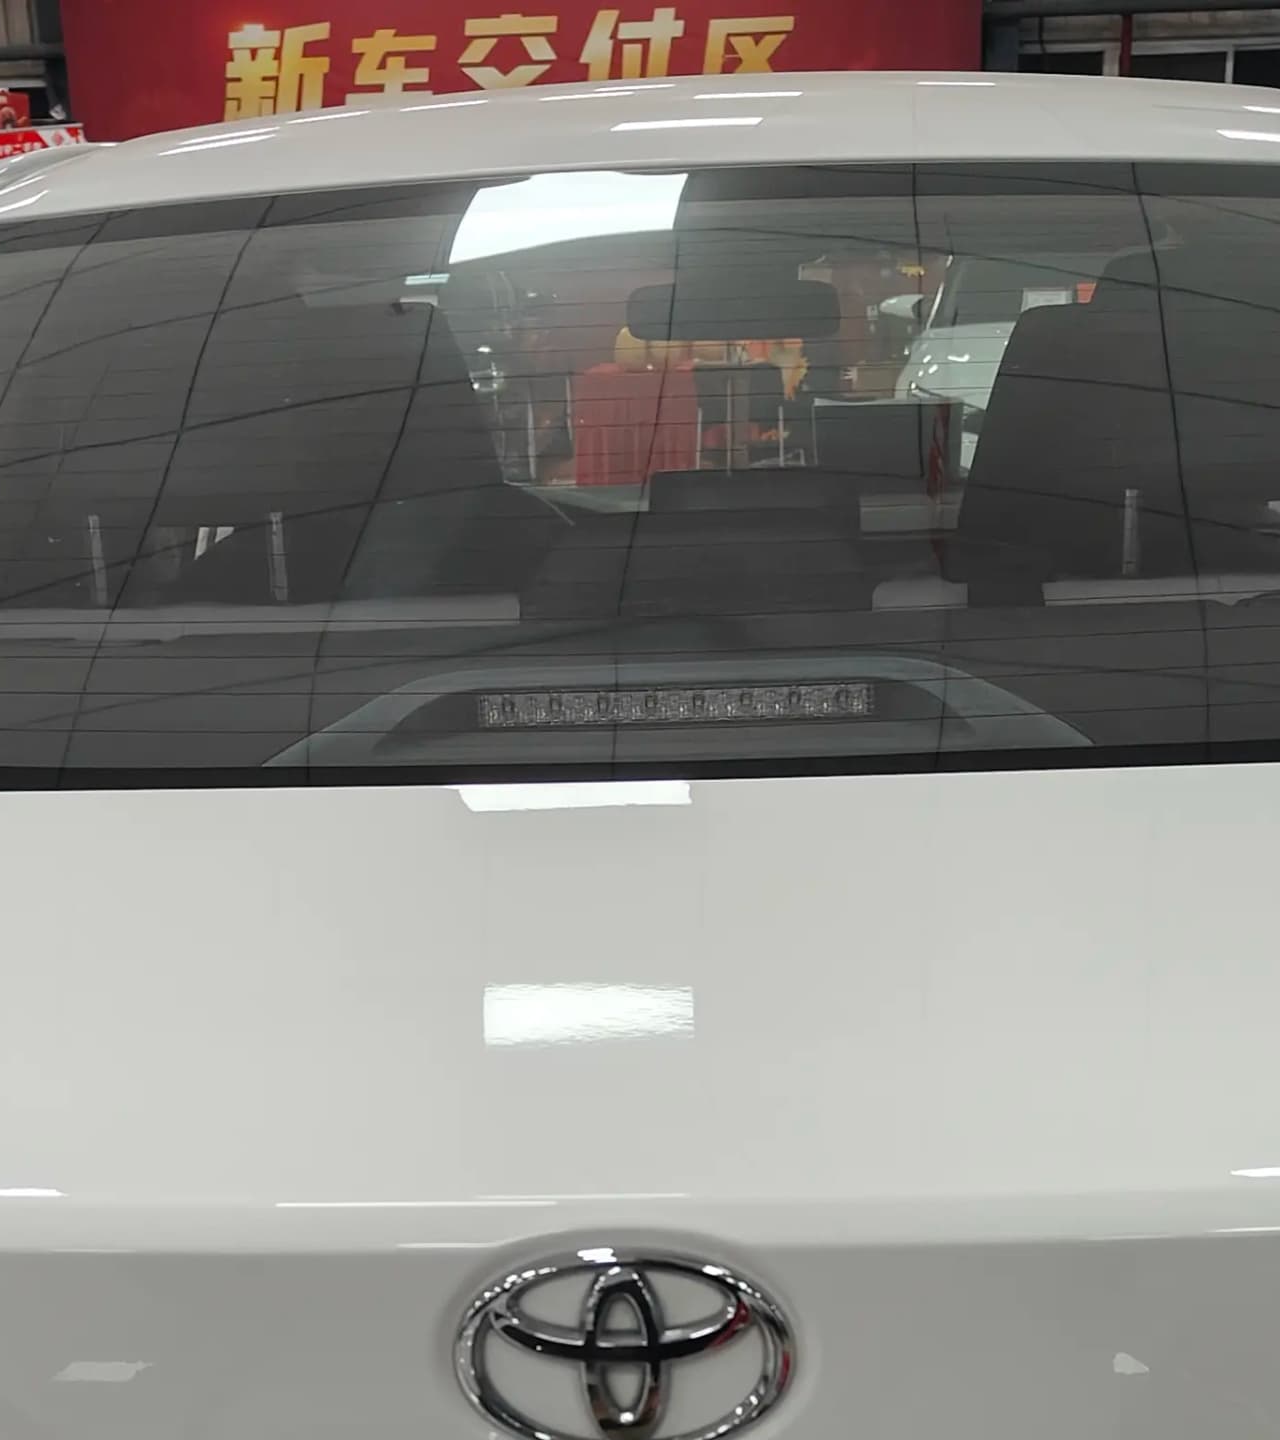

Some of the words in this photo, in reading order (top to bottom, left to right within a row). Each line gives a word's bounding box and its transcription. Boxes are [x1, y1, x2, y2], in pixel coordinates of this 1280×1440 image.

[223, 7, 795, 122] 新车交付区
